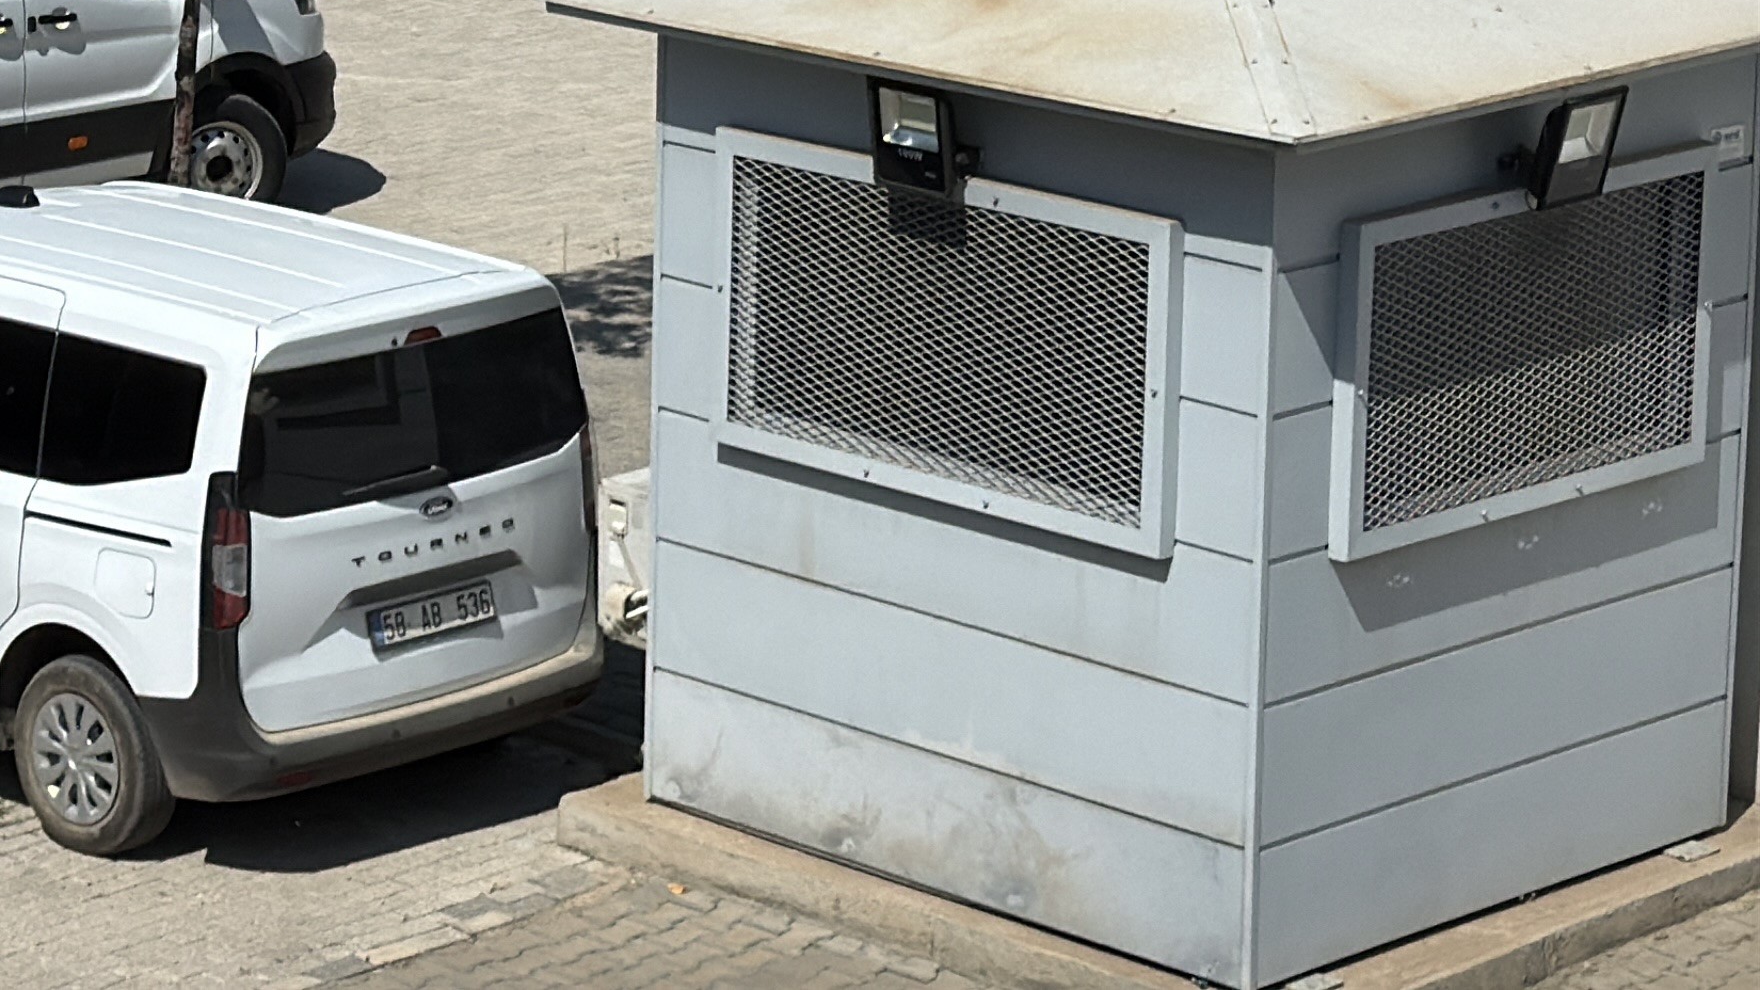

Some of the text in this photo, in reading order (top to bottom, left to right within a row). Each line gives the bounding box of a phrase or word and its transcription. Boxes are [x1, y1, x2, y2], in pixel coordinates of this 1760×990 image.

[352, 517, 515, 568] TOURNEO
[383, 589, 491, 640] 58 AB 536
